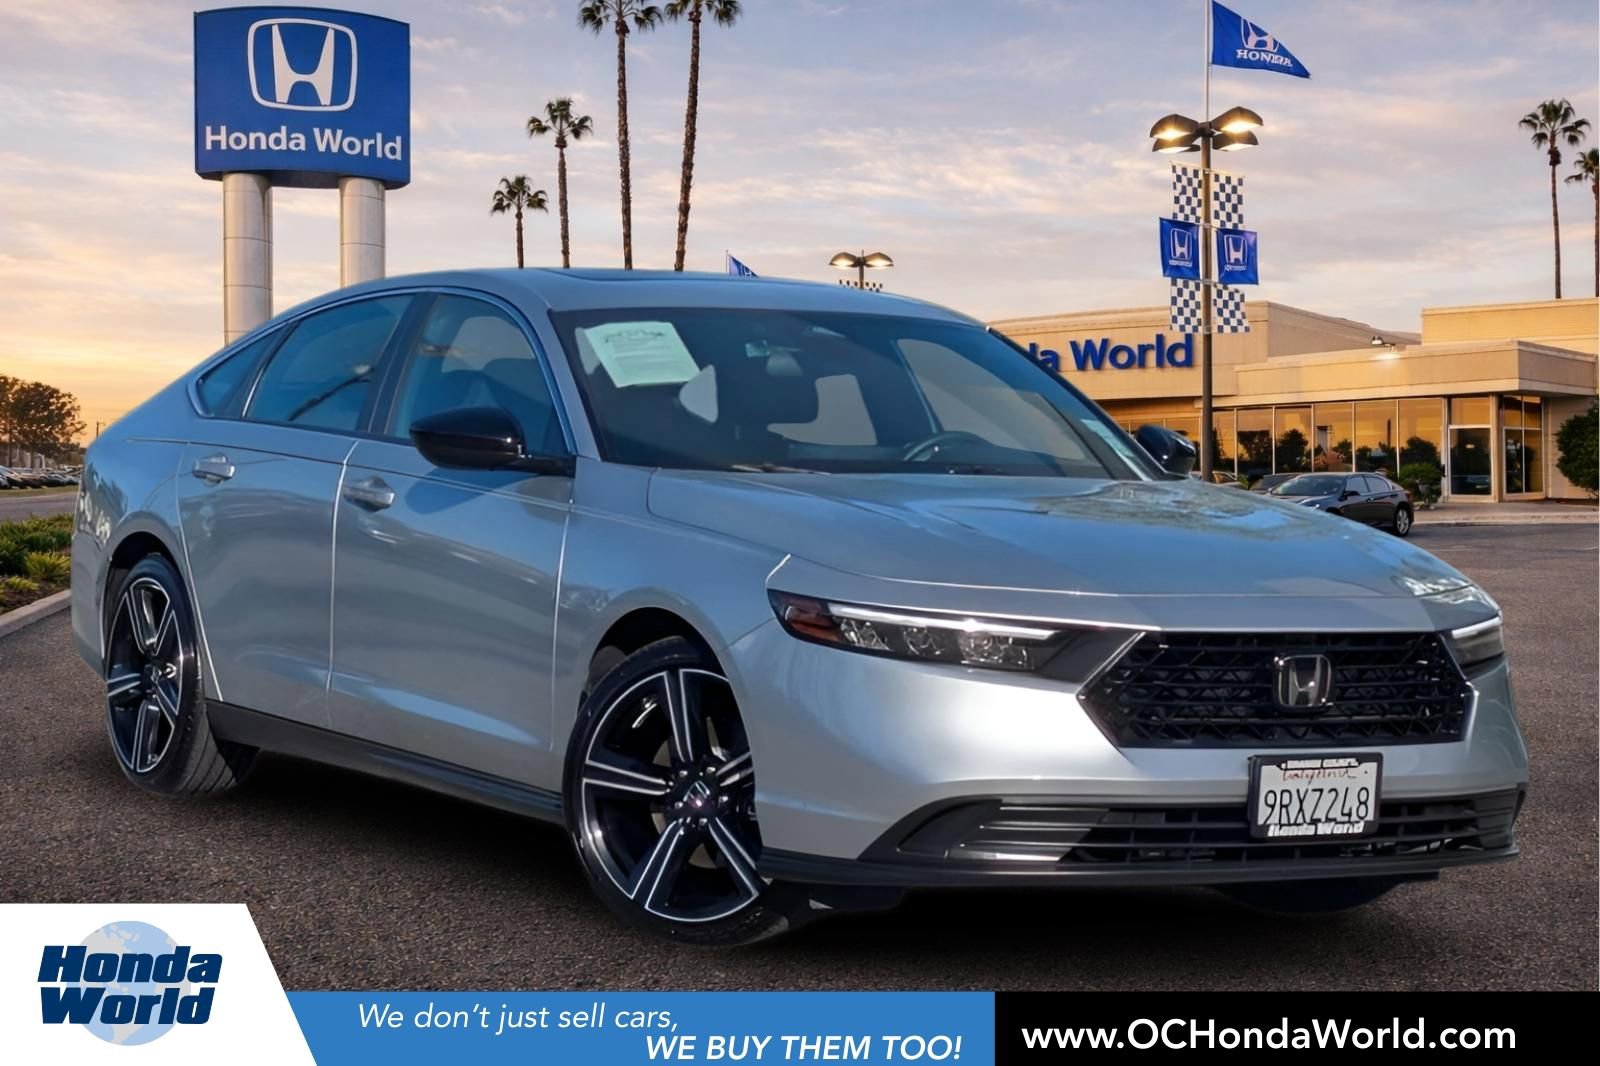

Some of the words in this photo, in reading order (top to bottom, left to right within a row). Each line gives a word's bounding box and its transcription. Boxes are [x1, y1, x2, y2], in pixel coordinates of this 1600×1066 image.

[205, 125, 306, 151] Honda
[312, 127, 402, 161] World
[1069, 333, 1193, 371] World
